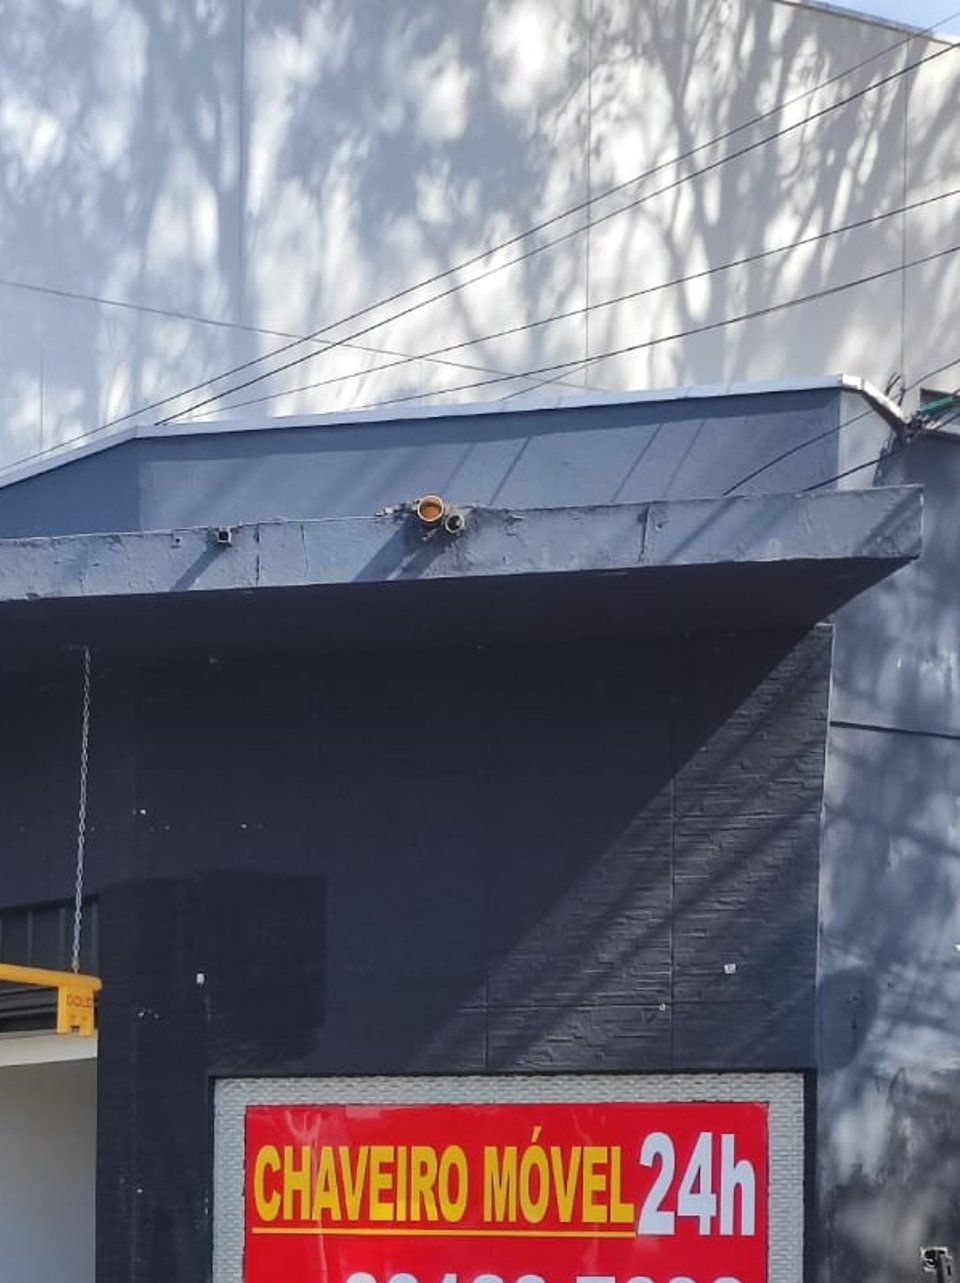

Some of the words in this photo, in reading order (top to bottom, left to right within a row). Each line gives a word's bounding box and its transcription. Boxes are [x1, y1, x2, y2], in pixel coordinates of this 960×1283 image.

[253, 1144, 469, 1223] CHAVEIRO
[483, 1126, 636, 1224] MÓVEL
[637, 1131, 757, 1236] 24h
